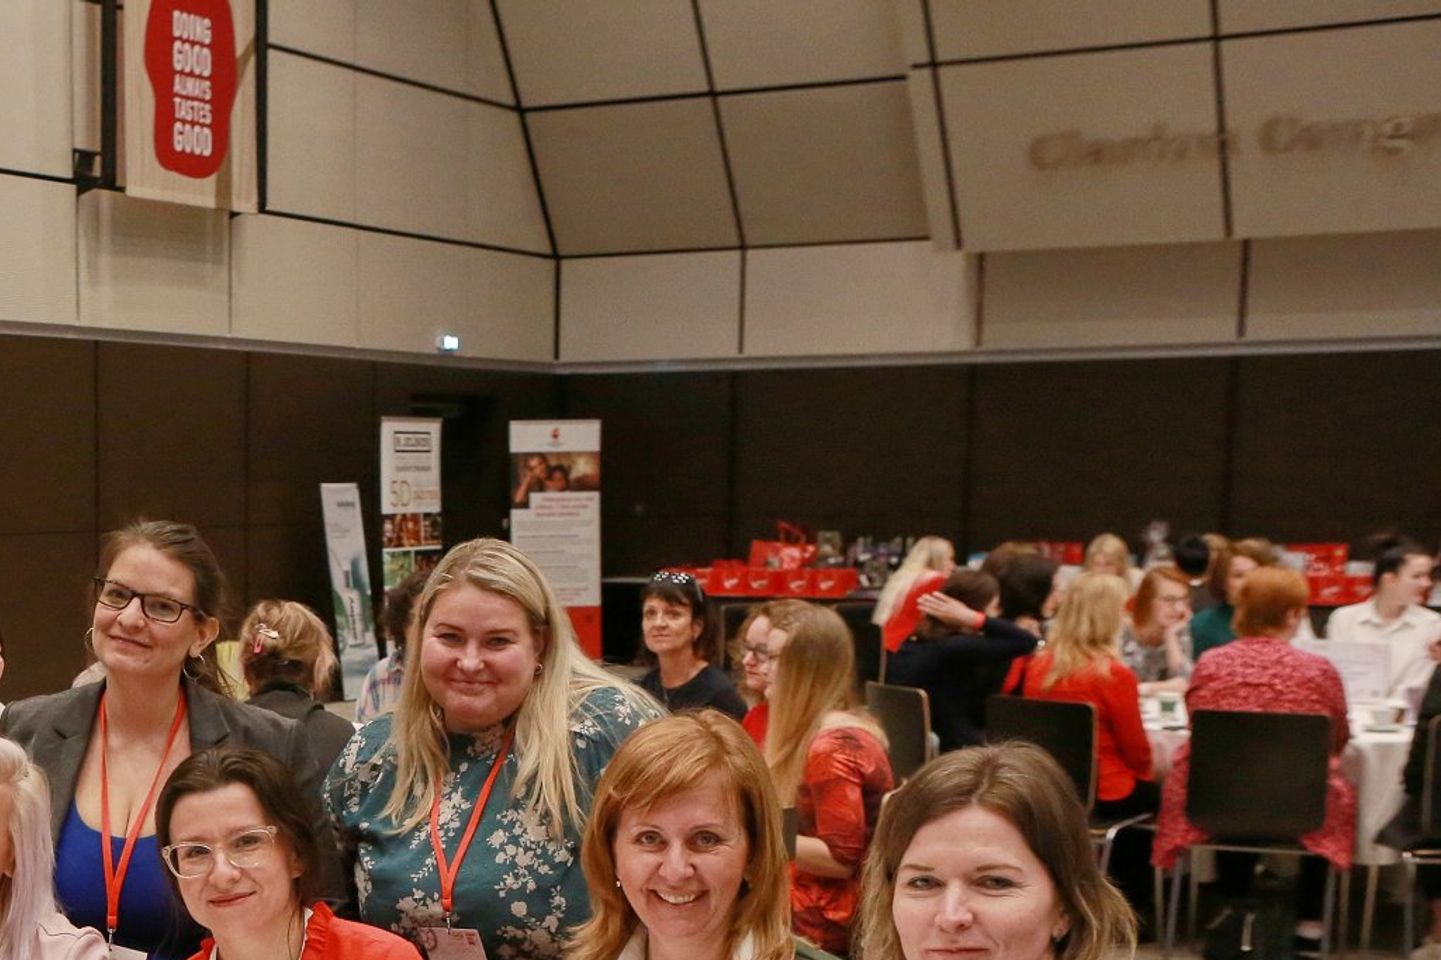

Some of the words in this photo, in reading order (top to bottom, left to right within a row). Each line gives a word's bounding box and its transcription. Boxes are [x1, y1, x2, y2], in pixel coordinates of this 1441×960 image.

[172, 10, 212, 45] DOING
[172, 39, 212, 77] GOOD
[172, 73, 212, 101] ALWAYS
[172, 97, 212, 126] TASTES
[172, 121, 213, 157] GOOD
